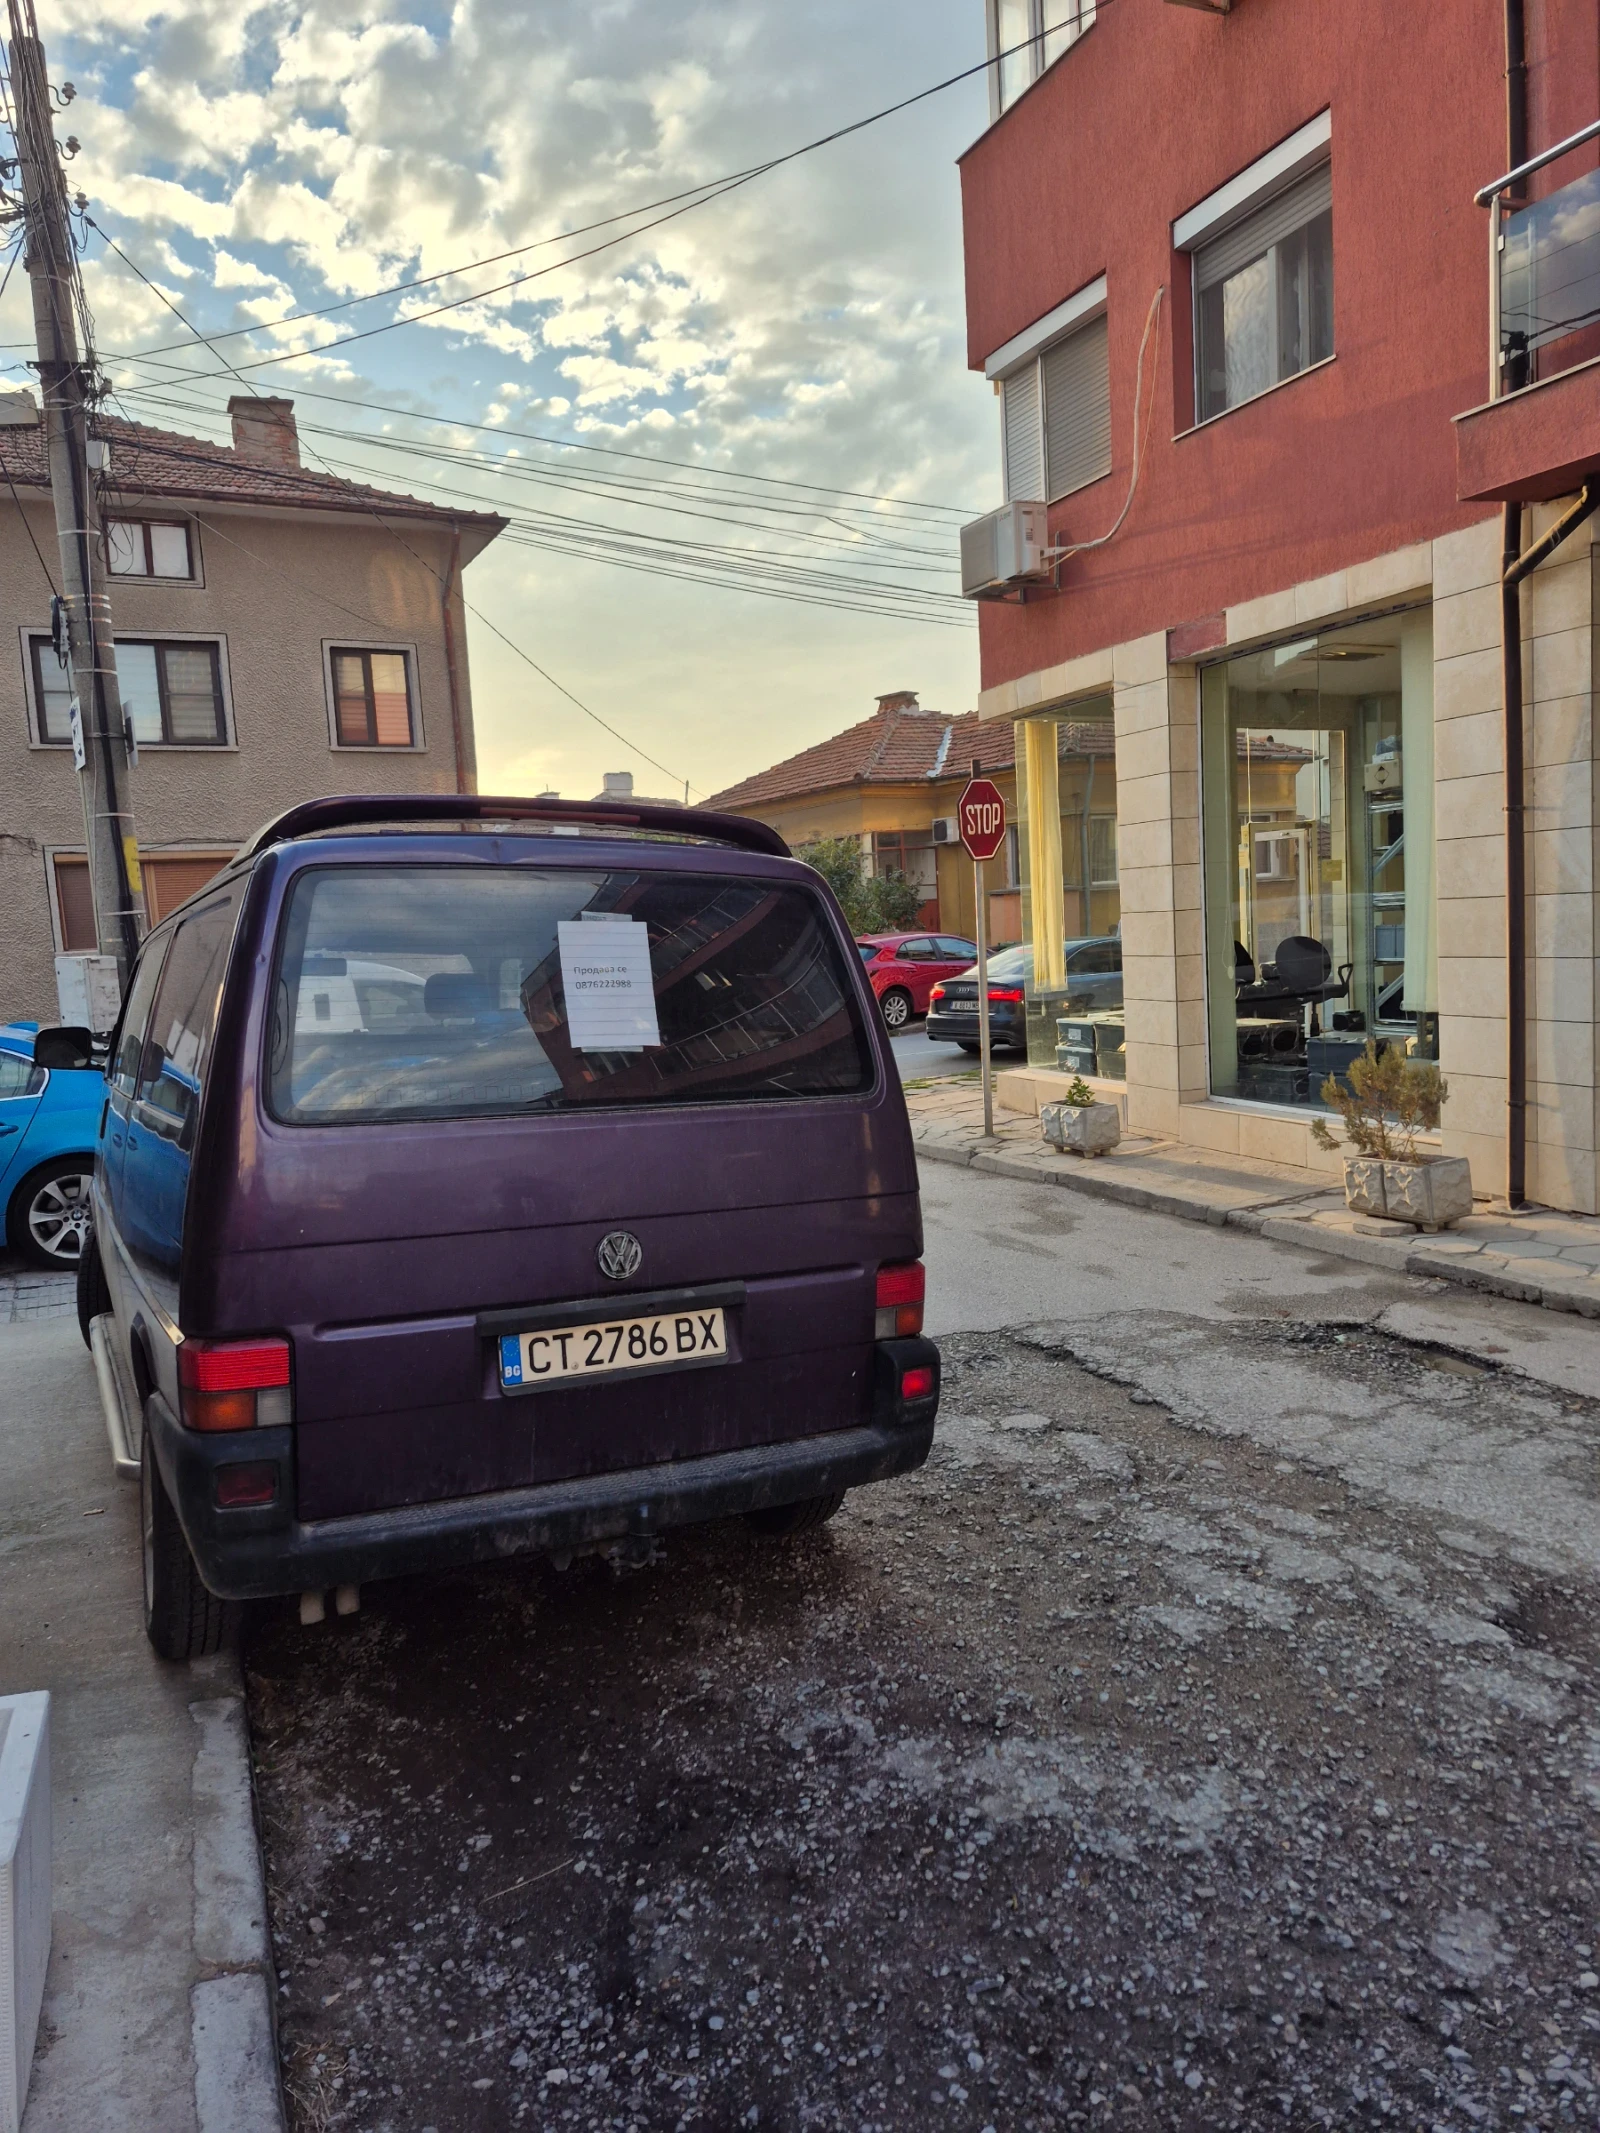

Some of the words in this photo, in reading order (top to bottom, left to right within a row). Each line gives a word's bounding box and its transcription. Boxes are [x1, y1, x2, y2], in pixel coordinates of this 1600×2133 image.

[966, 803, 1000, 835] STOP
[573, 966, 615, 976] Продава
[575, 979, 632, 990] 0876222988
[583, 1320, 669, 1367] 2786
[504, 1364, 521, 1378] BG
